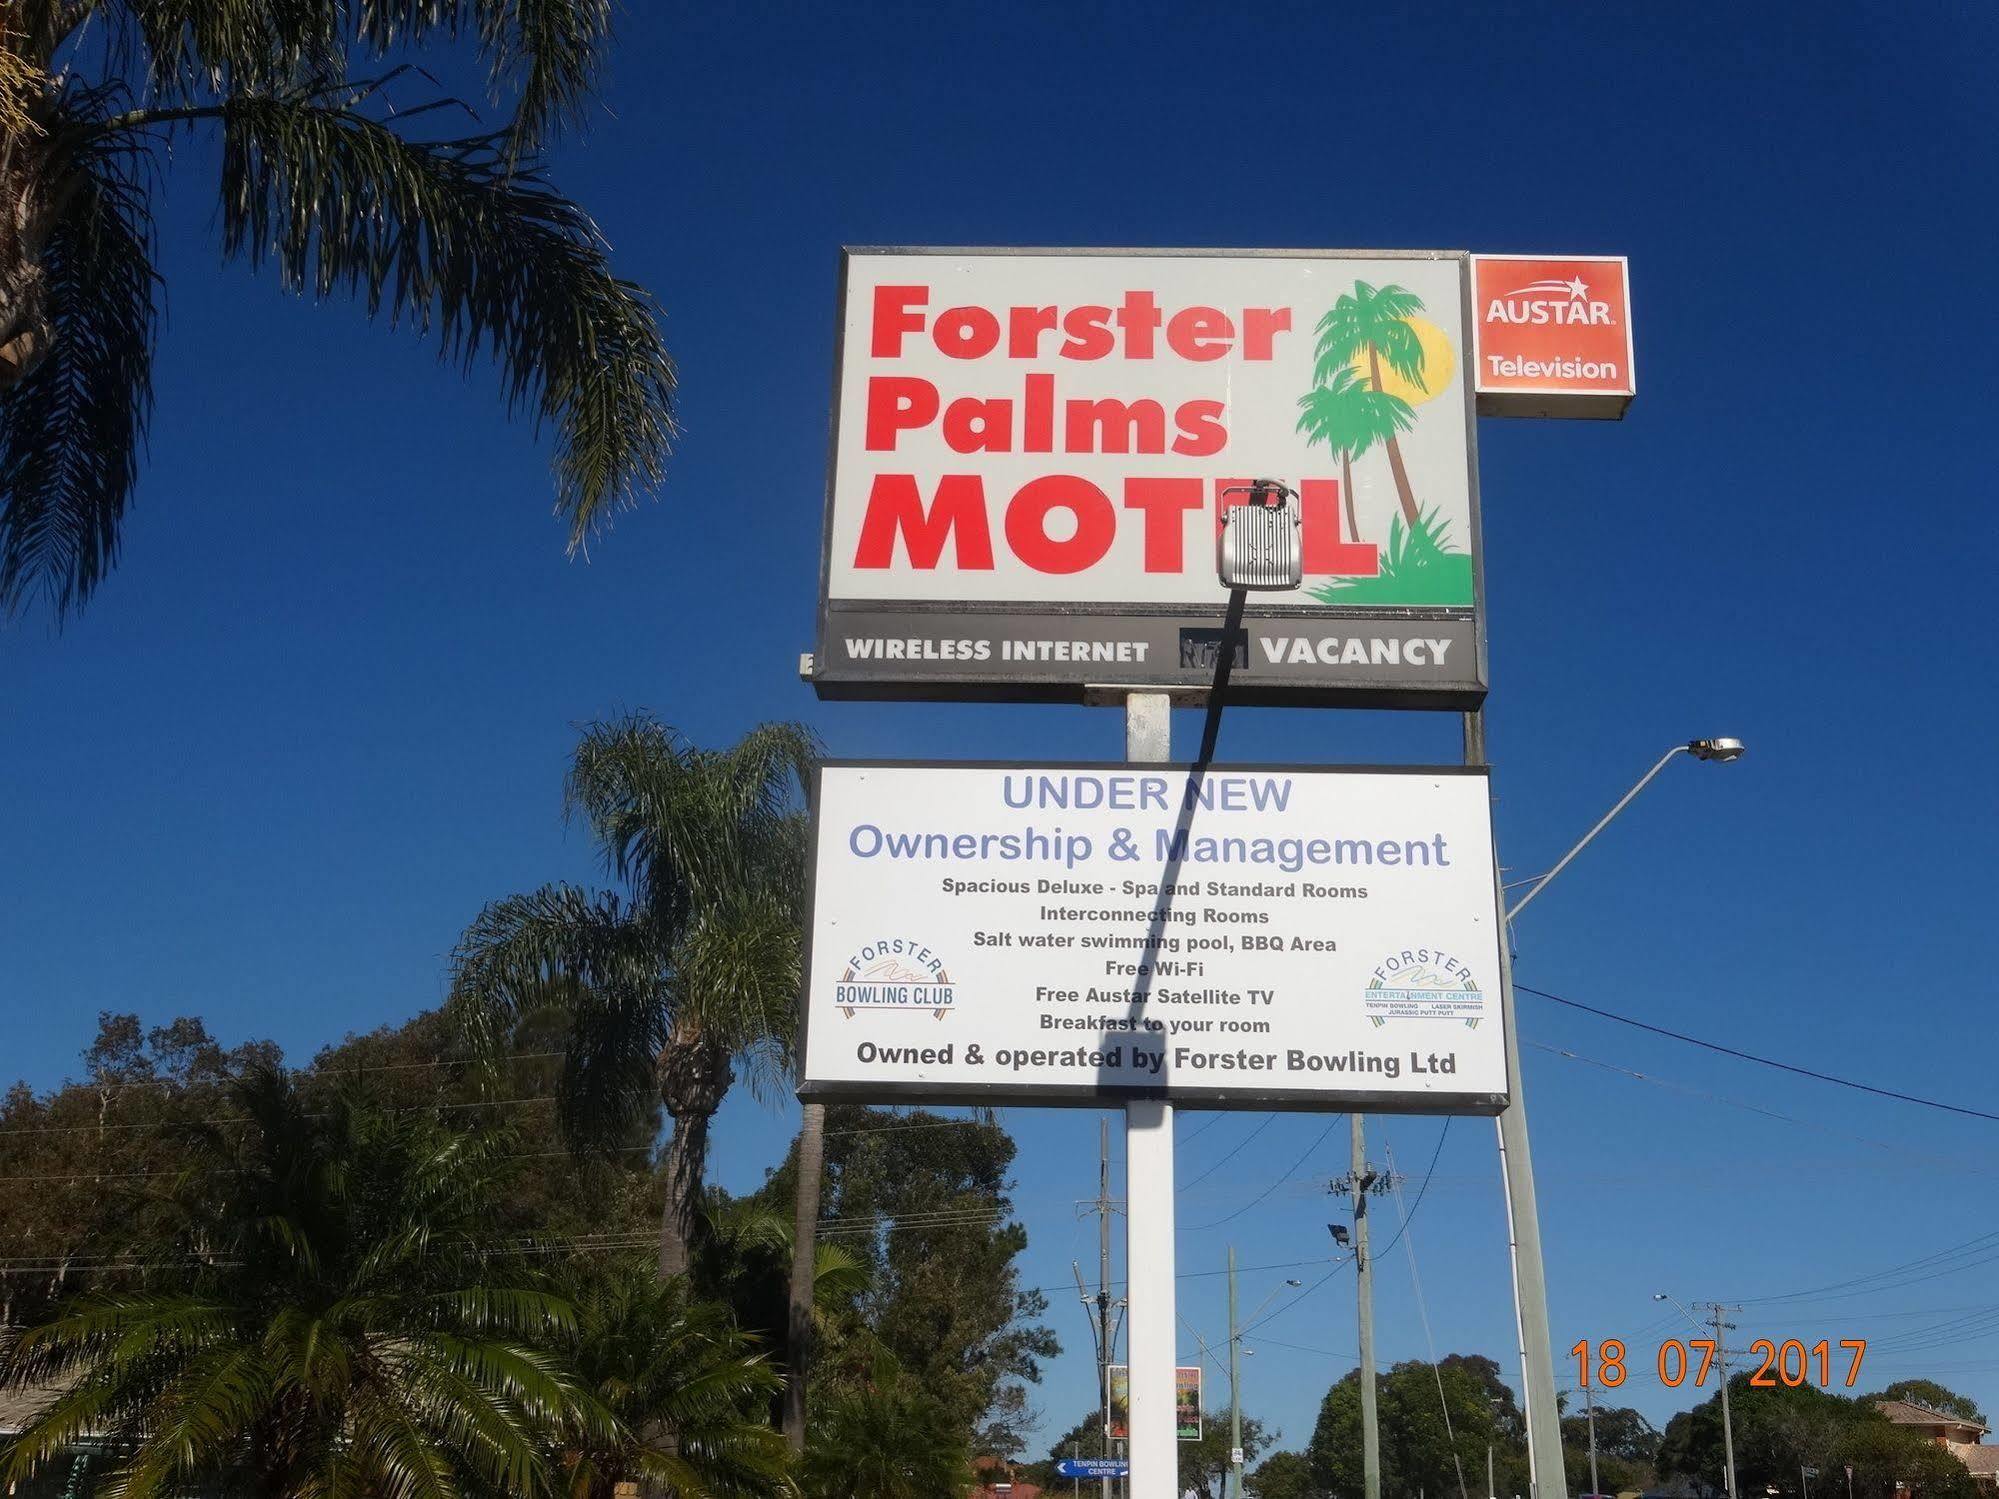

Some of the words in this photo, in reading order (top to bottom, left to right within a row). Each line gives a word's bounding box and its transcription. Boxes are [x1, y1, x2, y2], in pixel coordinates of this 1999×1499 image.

[871, 285, 1292, 362] Forster
[1486, 299, 1611, 325] AUSTAR
[1487, 355, 1616, 379] Television
[865, 374, 1228, 457] Palms
[845, 638, 991, 661] WIRELESS
[1002, 640, 1150, 662] INTERNET
[1259, 637, 1453, 666] VACANCY
[1003, 775, 1168, 810] UNDER
[1185, 778, 1292, 813] NEW
[849, 825, 1092, 869] Ownership
[1108, 829, 1139, 862] &
[1156, 828, 1450, 872] Management
[942, 878, 1032, 897] Spacious
[1037, 879, 1103, 895] Deluxe
[1122, 880, 1159, 899] Spa
[1165, 881, 1200, 896] and
[1207, 882, 1296, 898] Standard
[1301, 883, 1368, 899] Rooms
[1040, 906, 1197, 926] Interconnecting
[1202, 908, 1269, 923] Rooms
[973, 932, 1013, 948] Salt
[1018, 934, 1075, 949] water
[1081, 934, 1181, 953] swimming
[1187, 935, 1235, 953] pool,
[1241, 936, 1284, 953] BBQ
[1290, 937, 1336, 952] Area
[849, 939, 942, 973] FORSTER
[1374, 949, 1471, 982] FORSTER
[1105, 961, 1149, 976] Free
[1155, 961, 1204, 977] Wi-Fi
[837, 986, 907, 1003] BOWLING
[914, 988, 952, 1004] CLUB
[1035, 987, 1080, 1002] Free
[1086, 988, 1151, 1004] Austar
[1157, 989, 1243, 1005] Satellite
[1248, 990, 1274, 1005] TV
[1040, 1014, 1139, 1030] Breakfast
[1144, 1017, 1164, 1032] to
[1170, 1018, 1215, 1036] your
[1221, 1019, 1270, 1034] room
[857, 1042, 954, 1066] Owned
[965, 1044, 985, 1066] &
[995, 1045, 1123, 1073] operated
[1132, 1047, 1164, 1074] by
[1175, 1047, 1277, 1072] Forster
[1286, 1049, 1399, 1078] Bowling
[1410, 1052, 1456, 1075] Ltd
